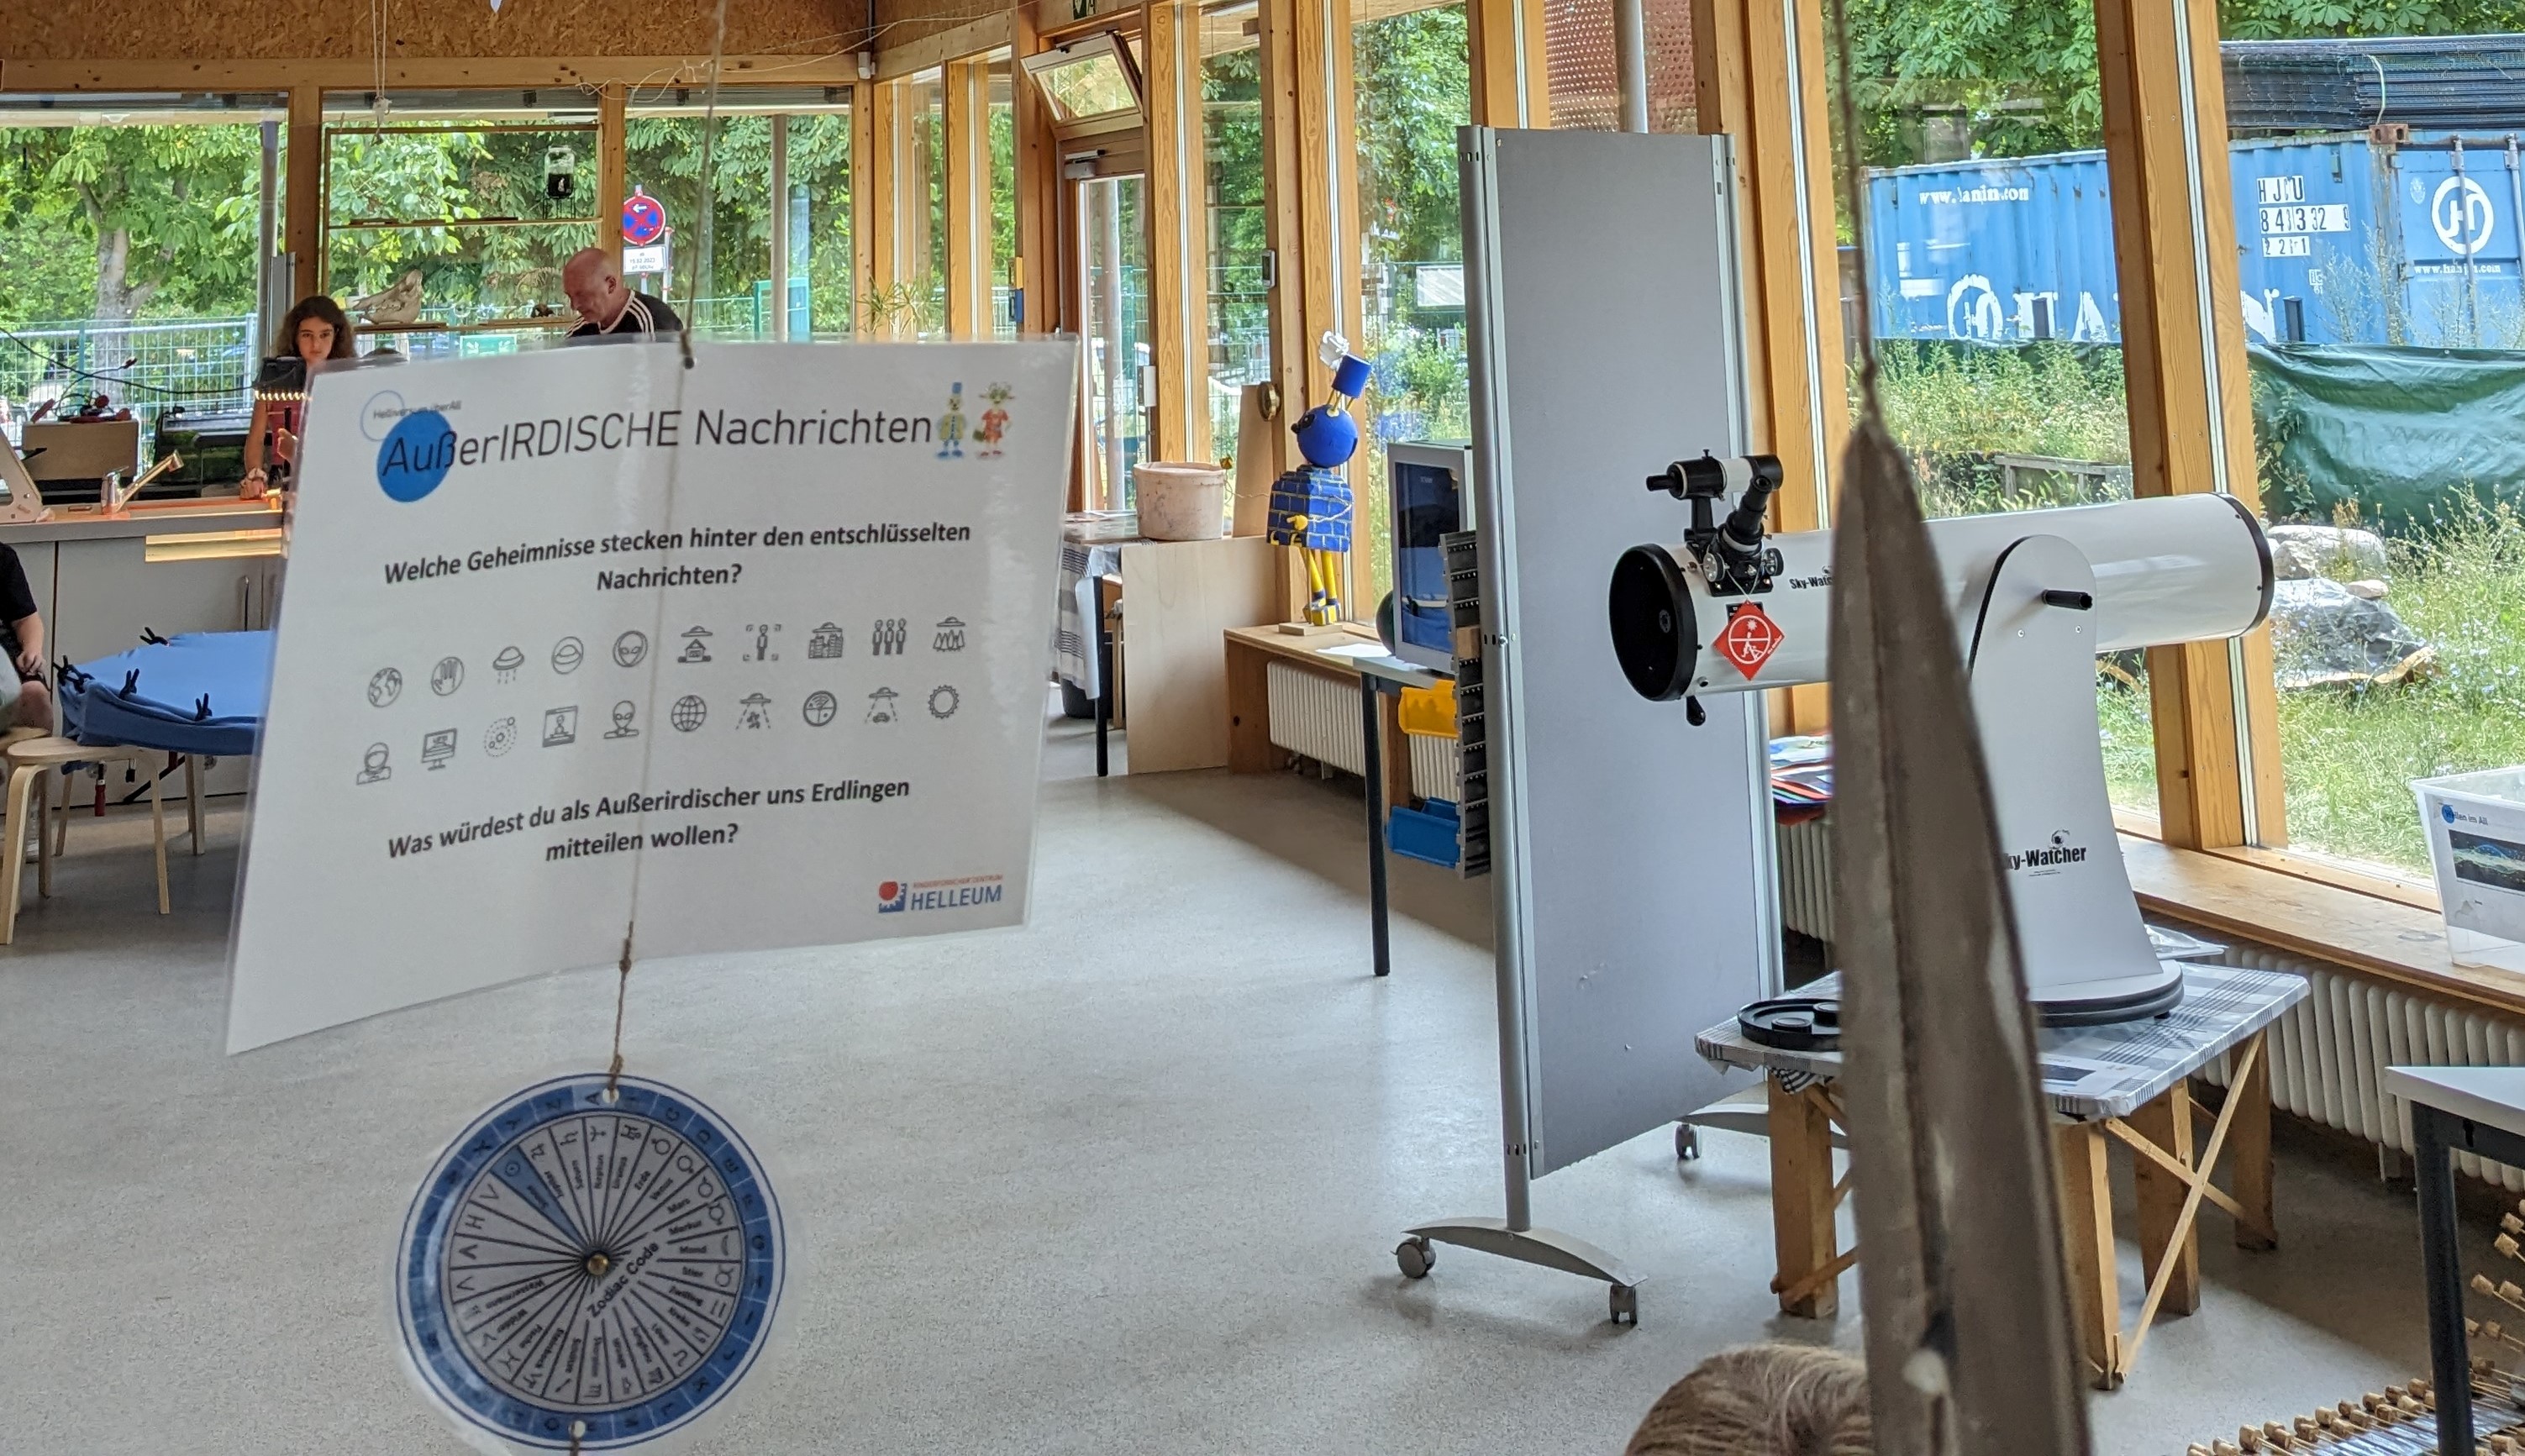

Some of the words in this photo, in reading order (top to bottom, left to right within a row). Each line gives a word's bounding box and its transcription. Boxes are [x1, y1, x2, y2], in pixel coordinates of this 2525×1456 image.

[381, 409, 684, 477] AußerIRDISCHE
[695, 408, 932, 445] Nachrichten
[384, 555, 462, 585] Welche
[466, 537, 596, 572] Geheimnisse
[599, 529, 683, 554] stecken
[689, 527, 758, 548] hinter
[762, 525, 804, 547] den
[809, 521, 971, 546] entschlüsselten
[597, 563, 743, 591] Nachrichten?
[388, 834, 434, 859] Was
[439, 812, 525, 848] würdest
[529, 805, 555, 828] du
[560, 799, 591, 823] als
[595, 786, 761, 817] Außerirdischer
[766, 788, 805, 806] uns
[811, 779, 910, 803] Erdlingen
[544, 831, 644, 862] mitteilen
[650, 823, 739, 849] wollen?
[911, 885, 1002, 911] HELLEUM
[587, 1275, 629, 1318] Zodiac
[625, 1242, 660, 1275] Code
